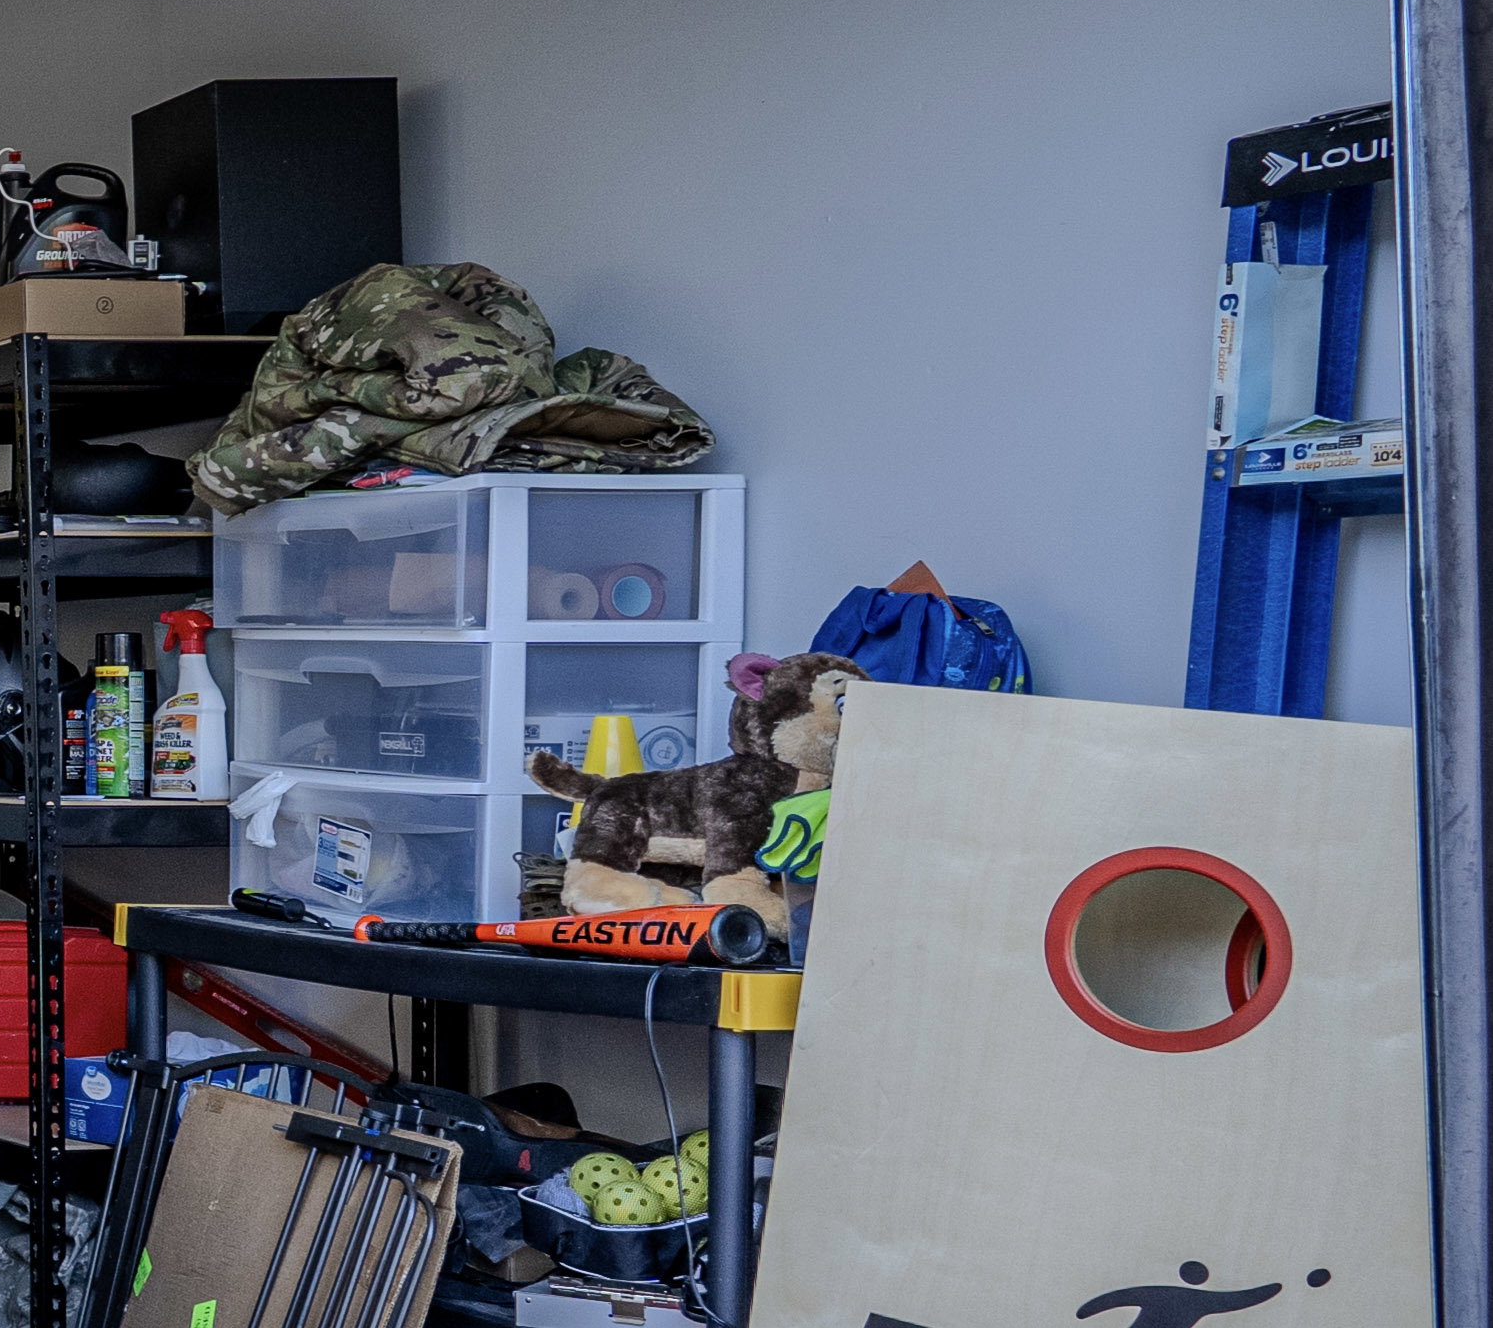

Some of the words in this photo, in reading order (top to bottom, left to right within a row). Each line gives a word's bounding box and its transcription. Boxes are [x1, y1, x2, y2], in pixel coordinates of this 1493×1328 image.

[1302, 138, 1395, 173] LOUI
[1294, 459, 1321, 471] step
[1323, 455, 1361, 469] ladder
[551, 920, 697, 946] EASTON
